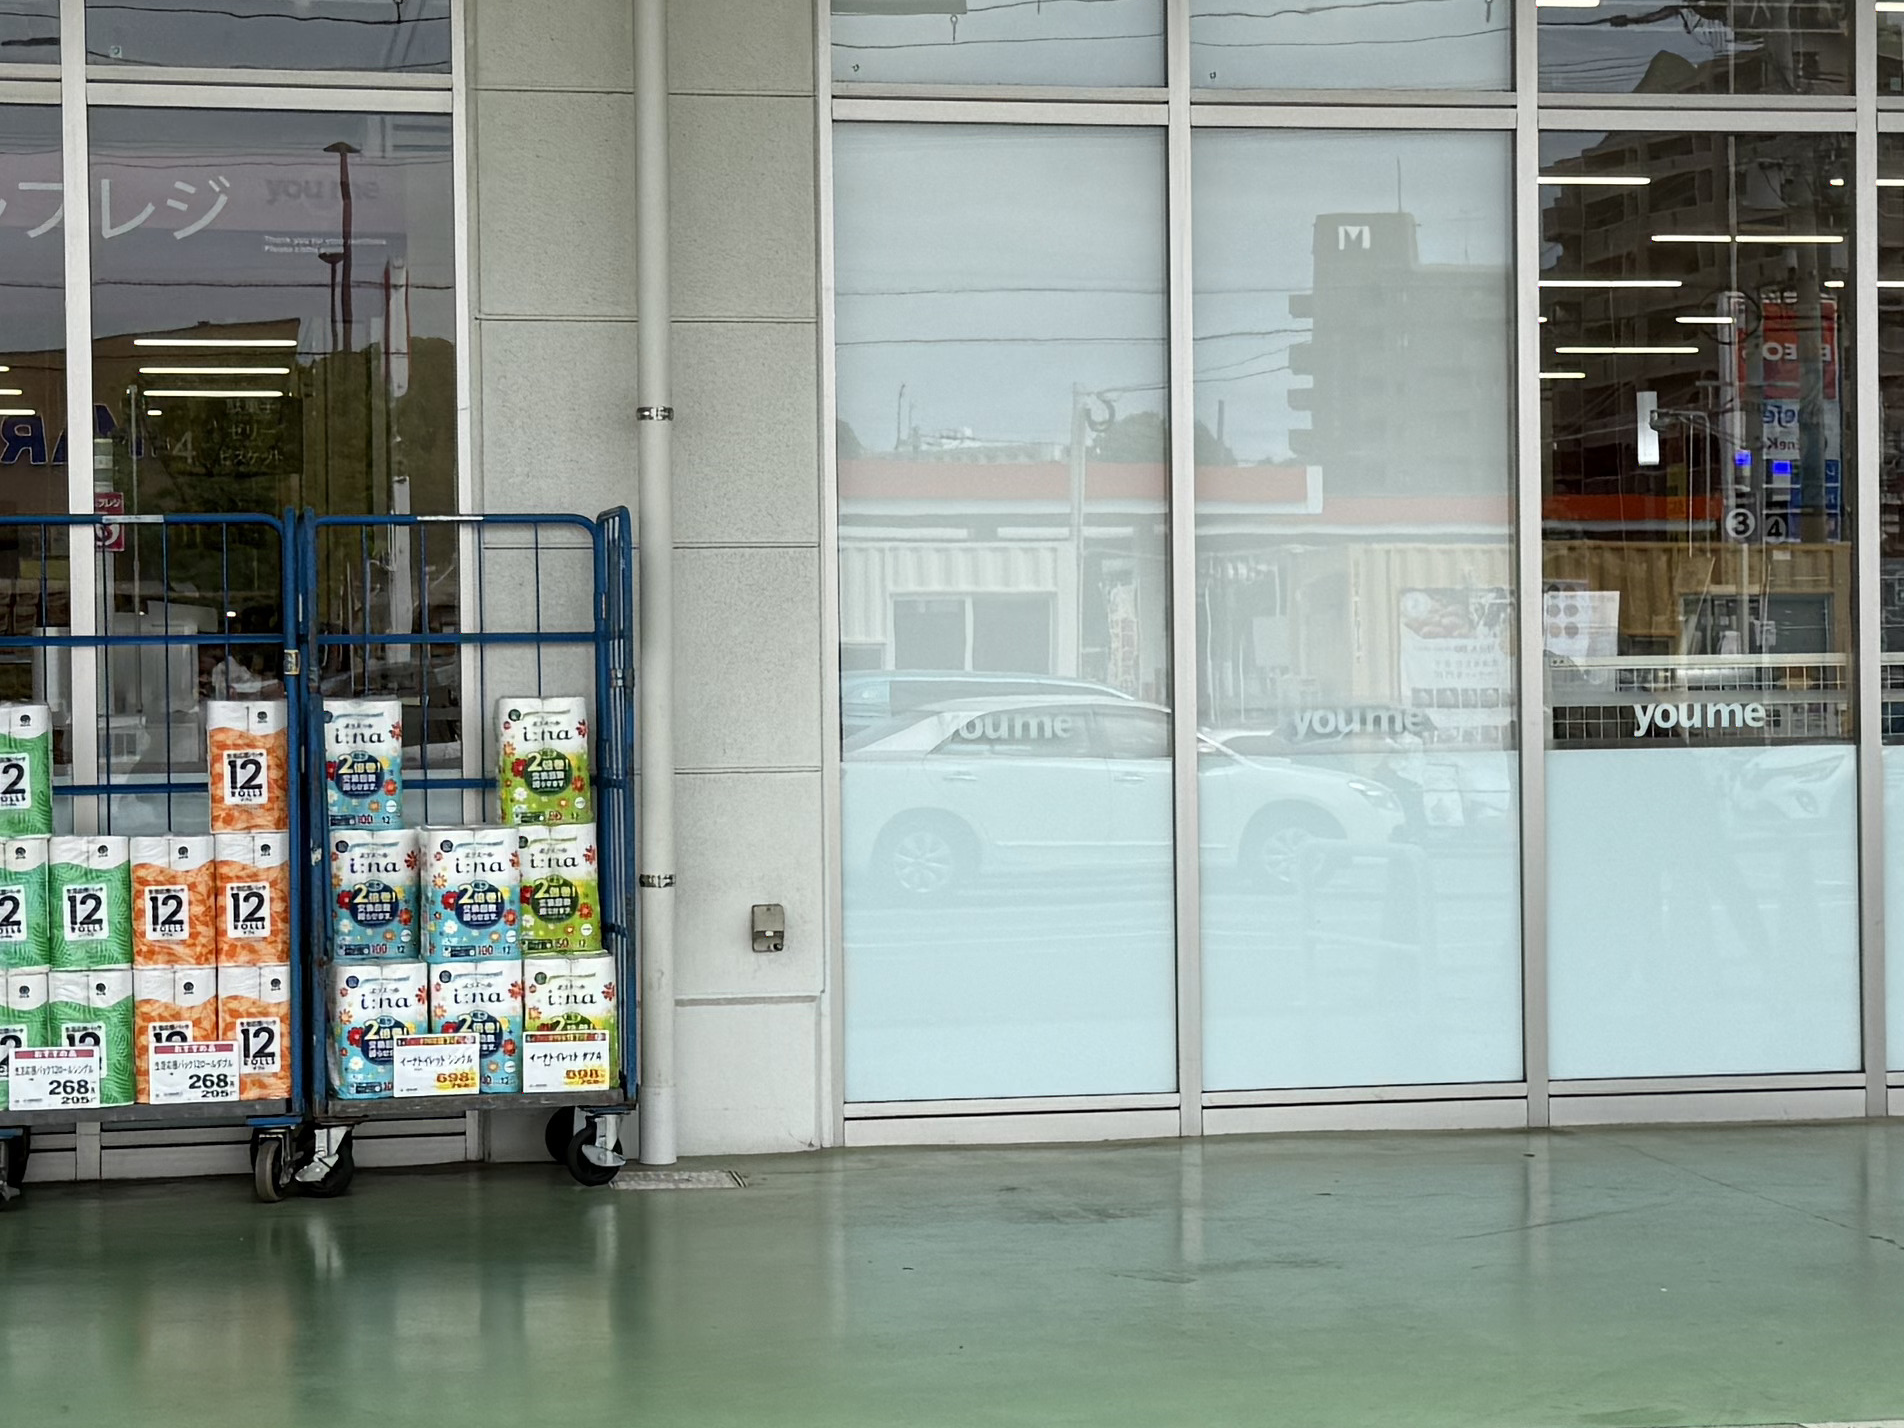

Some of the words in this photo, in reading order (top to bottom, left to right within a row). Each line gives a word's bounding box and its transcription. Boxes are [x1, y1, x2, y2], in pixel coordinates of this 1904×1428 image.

[228, 758, 263, 790] 12
[67, 893, 103, 926] 12
[149, 894, 185, 926] 12
[231, 891, 266, 922] 12
[241, 1026, 276, 1058] 12
[48, 1079, 90, 1095] 268
[188, 1073, 229, 1090] 268
